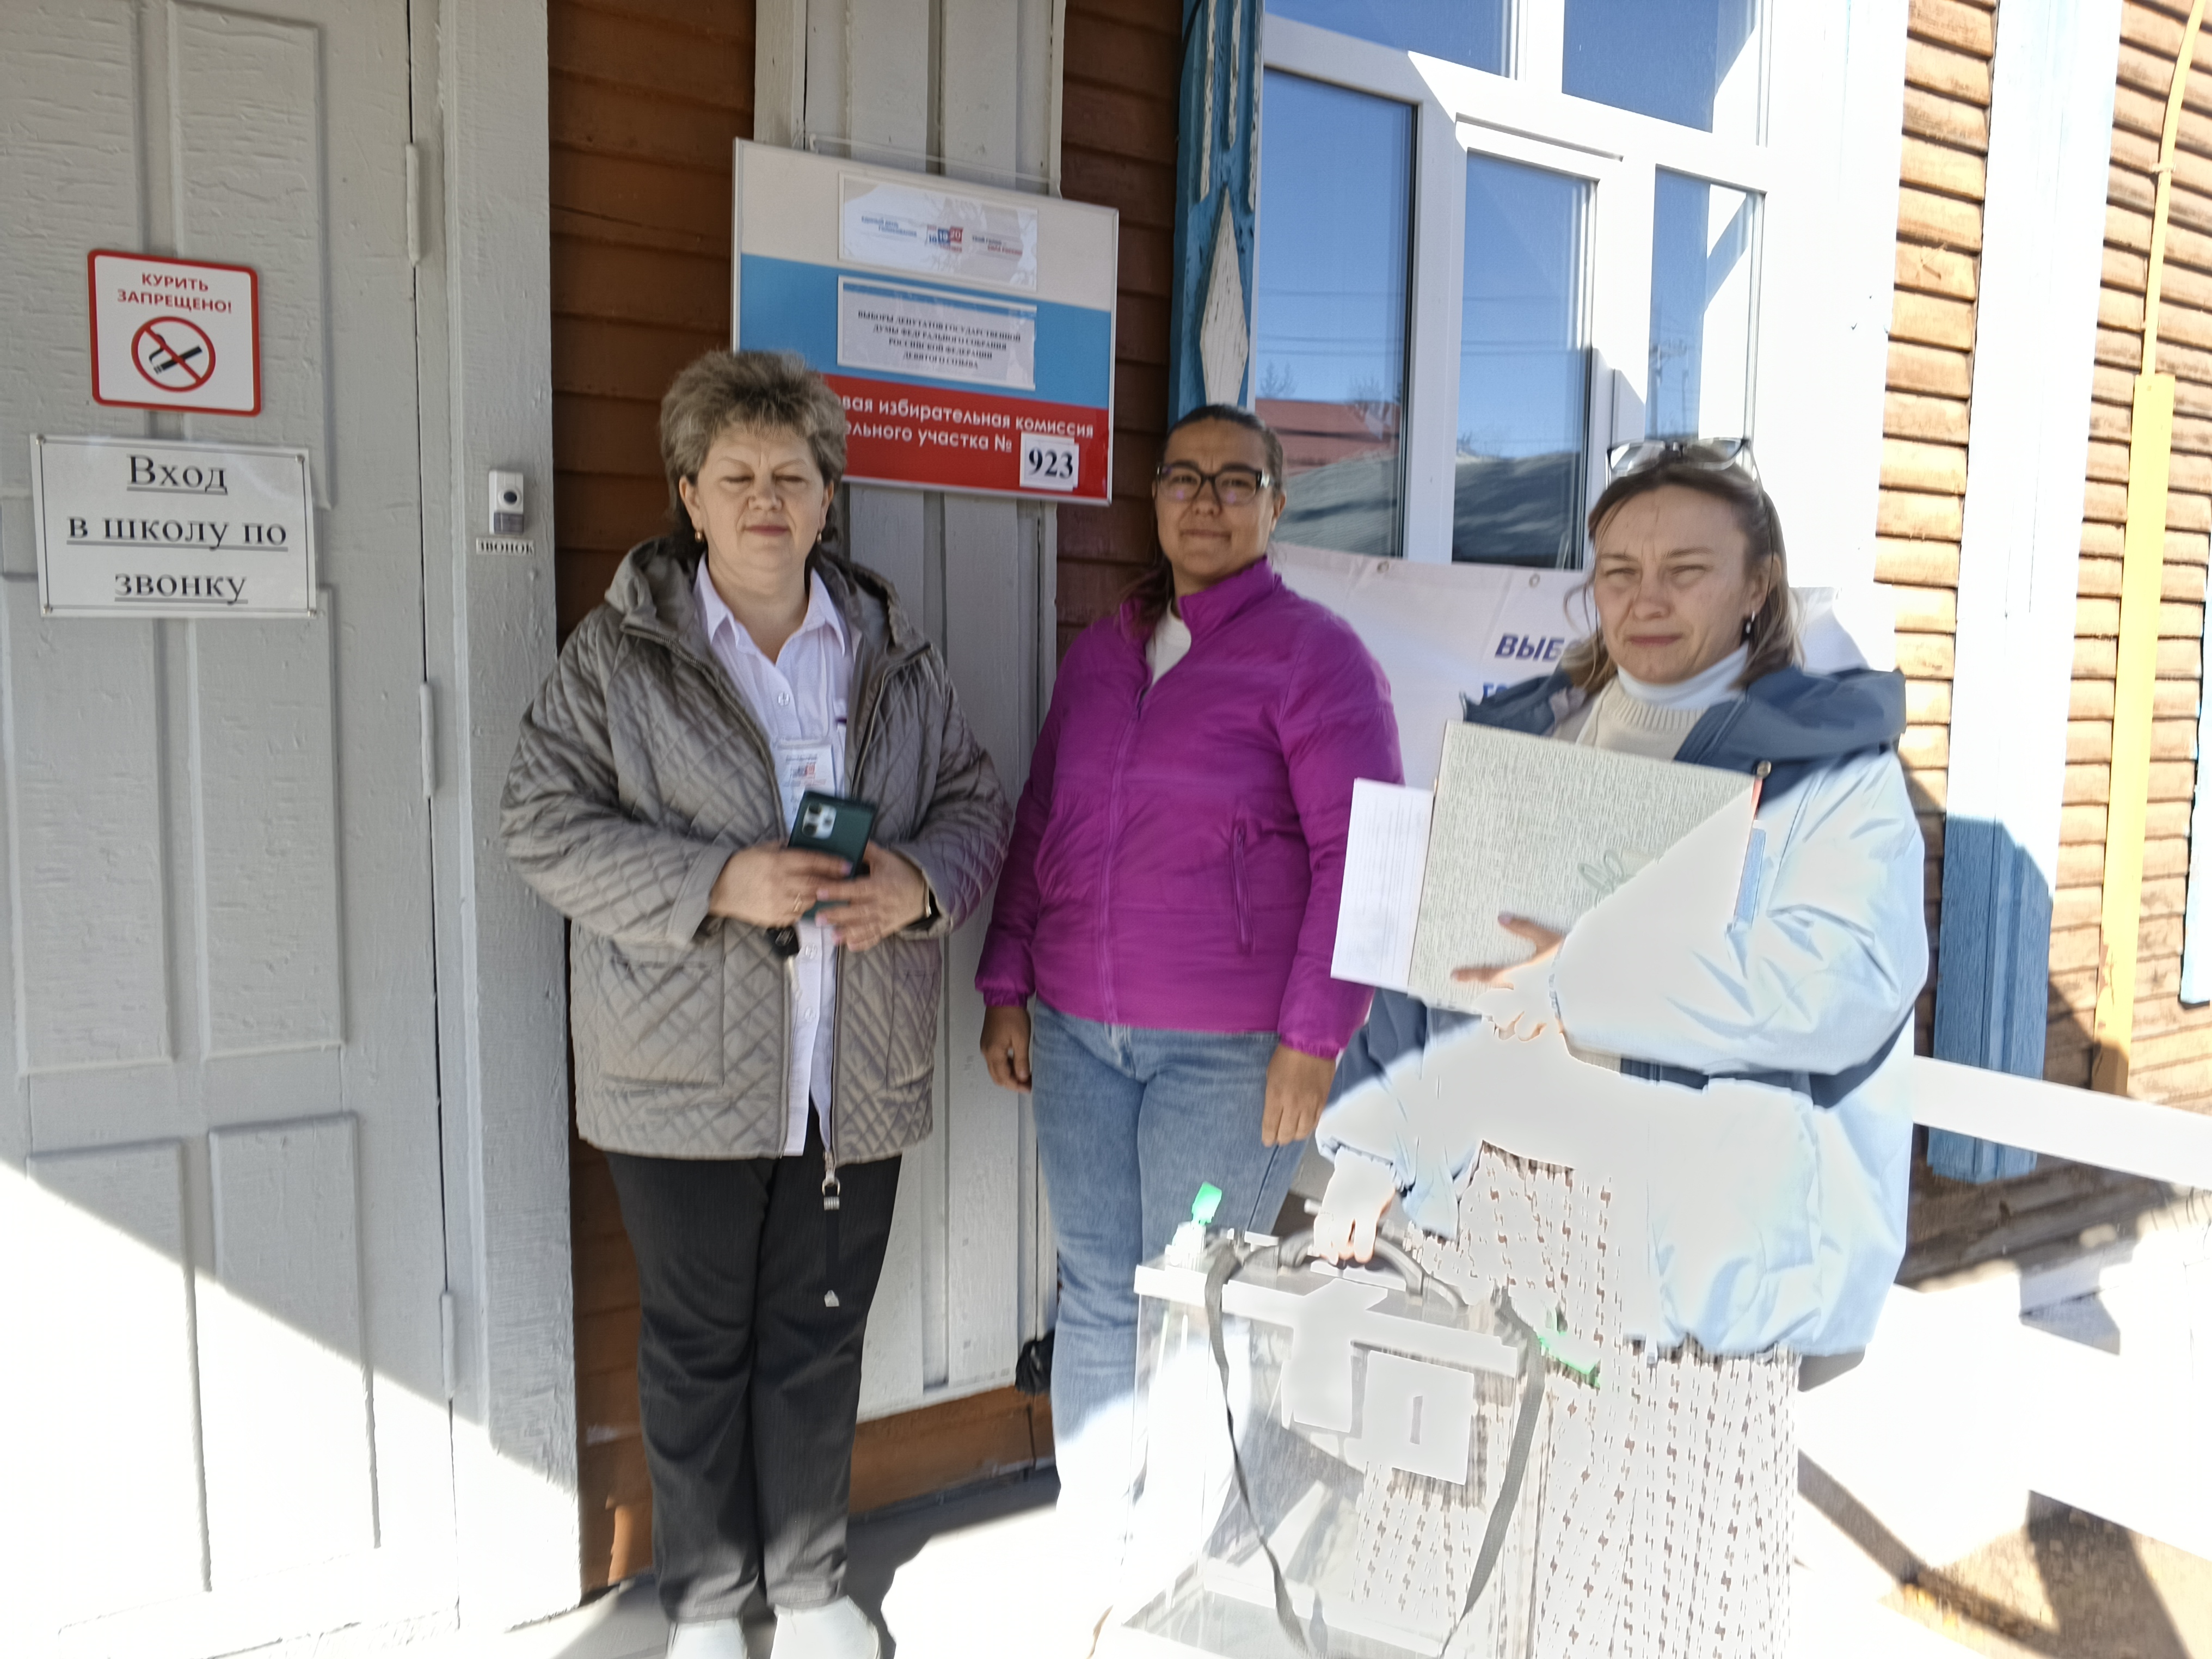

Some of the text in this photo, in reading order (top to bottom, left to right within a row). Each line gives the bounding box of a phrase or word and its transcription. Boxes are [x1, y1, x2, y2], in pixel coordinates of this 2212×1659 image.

[142, 273, 208, 292] КУРИТЬ
[117, 289, 232, 314] ЗАПРЕЩЕНО!
[858, 310, 1021, 343] ВЫБОРЫ ДЕПУТАТОВ ГОСУДАРСТВЕННОЙ
[879, 398, 1010, 429] избирательная
[1016, 416, 1093, 439] комиссия
[918, 428, 989, 451] участка
[995, 433, 1012, 453] №
[126, 453, 228, 495] Вход
[1028, 446, 1073, 479] 923
[67, 516, 286, 551] в школу по
[114, 573, 247, 606] звонку
